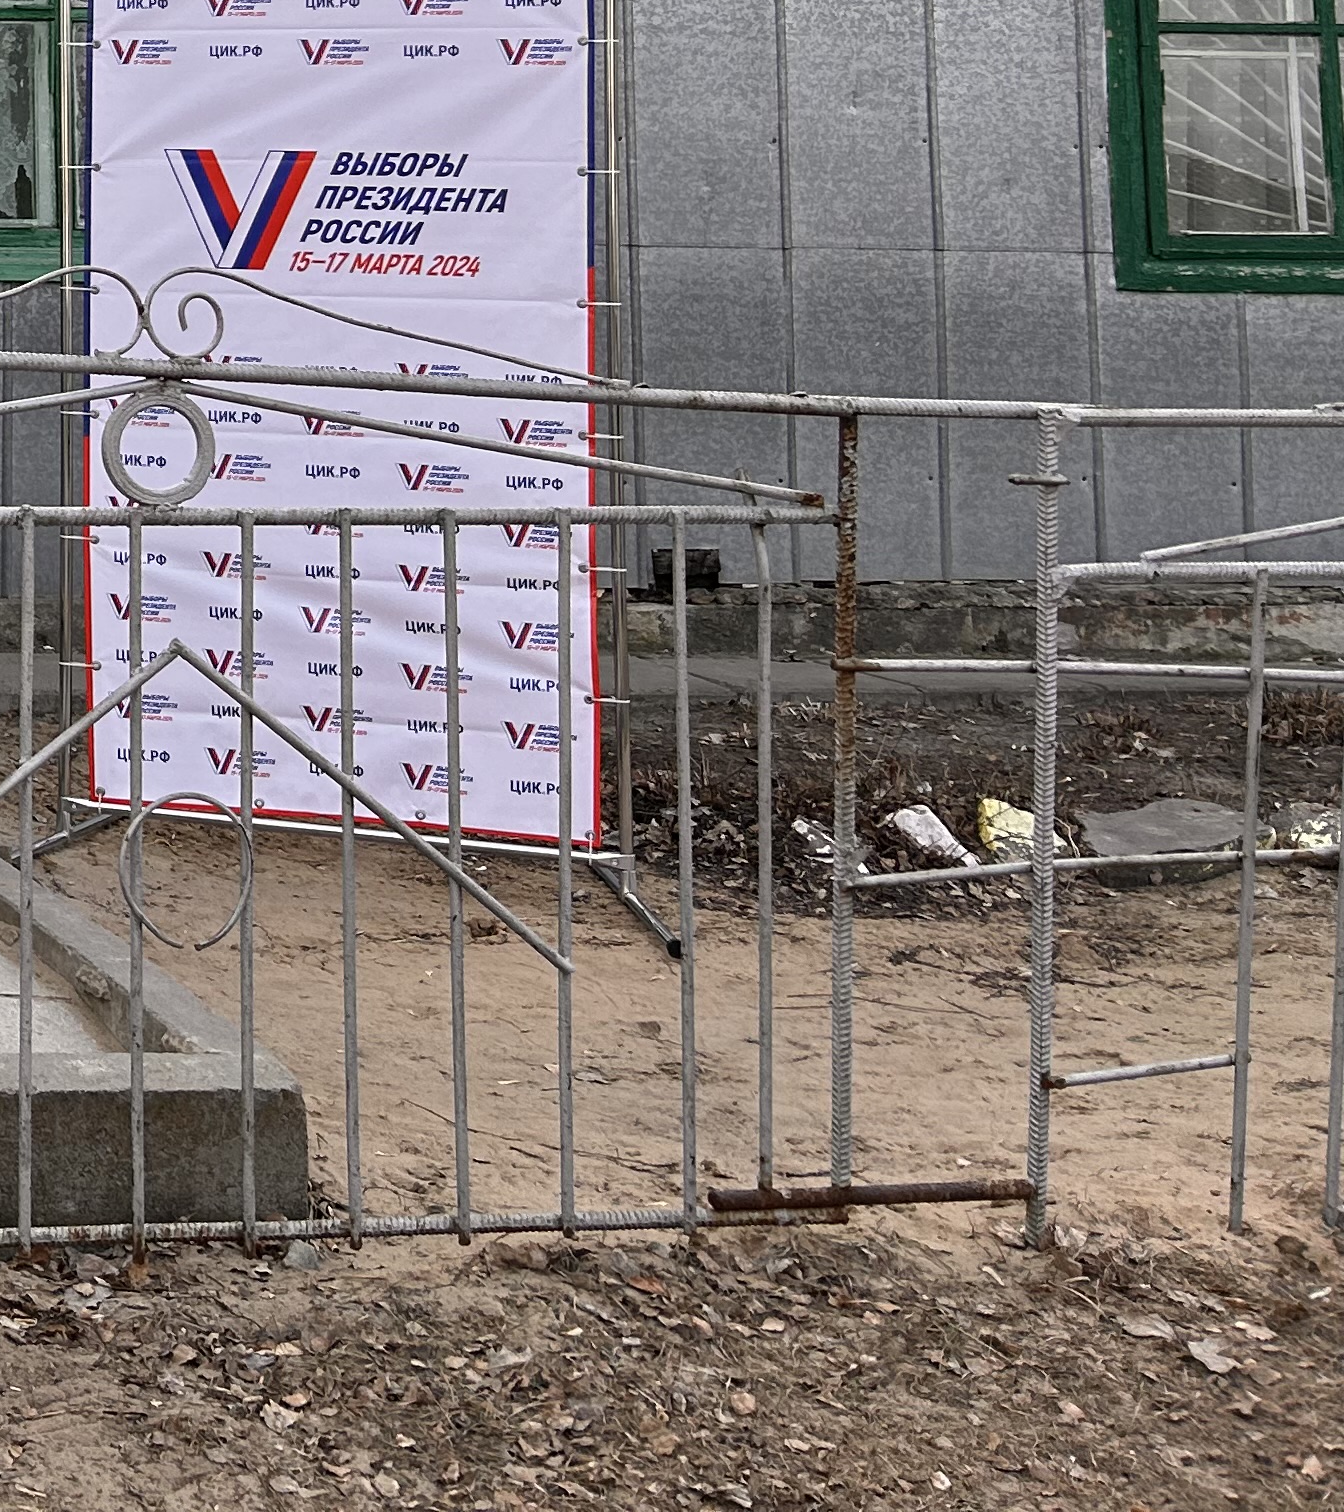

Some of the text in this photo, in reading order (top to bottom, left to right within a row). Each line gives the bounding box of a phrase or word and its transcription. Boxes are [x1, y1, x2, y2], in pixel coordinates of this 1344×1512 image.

[209, 45, 263, 60] ЦИК.РФ
[403, 44, 460, 60] ЦИК.РФ
[330, 151, 469, 178] ВЫБОРЫ
[315, 185, 509, 216] ПРЕЗИДЕНТА
[299, 219, 425, 246] РОССИИ
[352, 253, 425, 275] МАРТА
[425, 255, 481, 278] 2024
[208, 410, 262, 425] ЦИК.РФ
[305, 464, 361, 479] ЦИК.РФ
[505, 475, 564, 491] ЦИК.РФ
[305, 564, 361, 580] ЦИК.Ф
[209, 606, 264, 622] ЦИК.Ф
[307, 661, 363, 678] ЦИК.Ф
